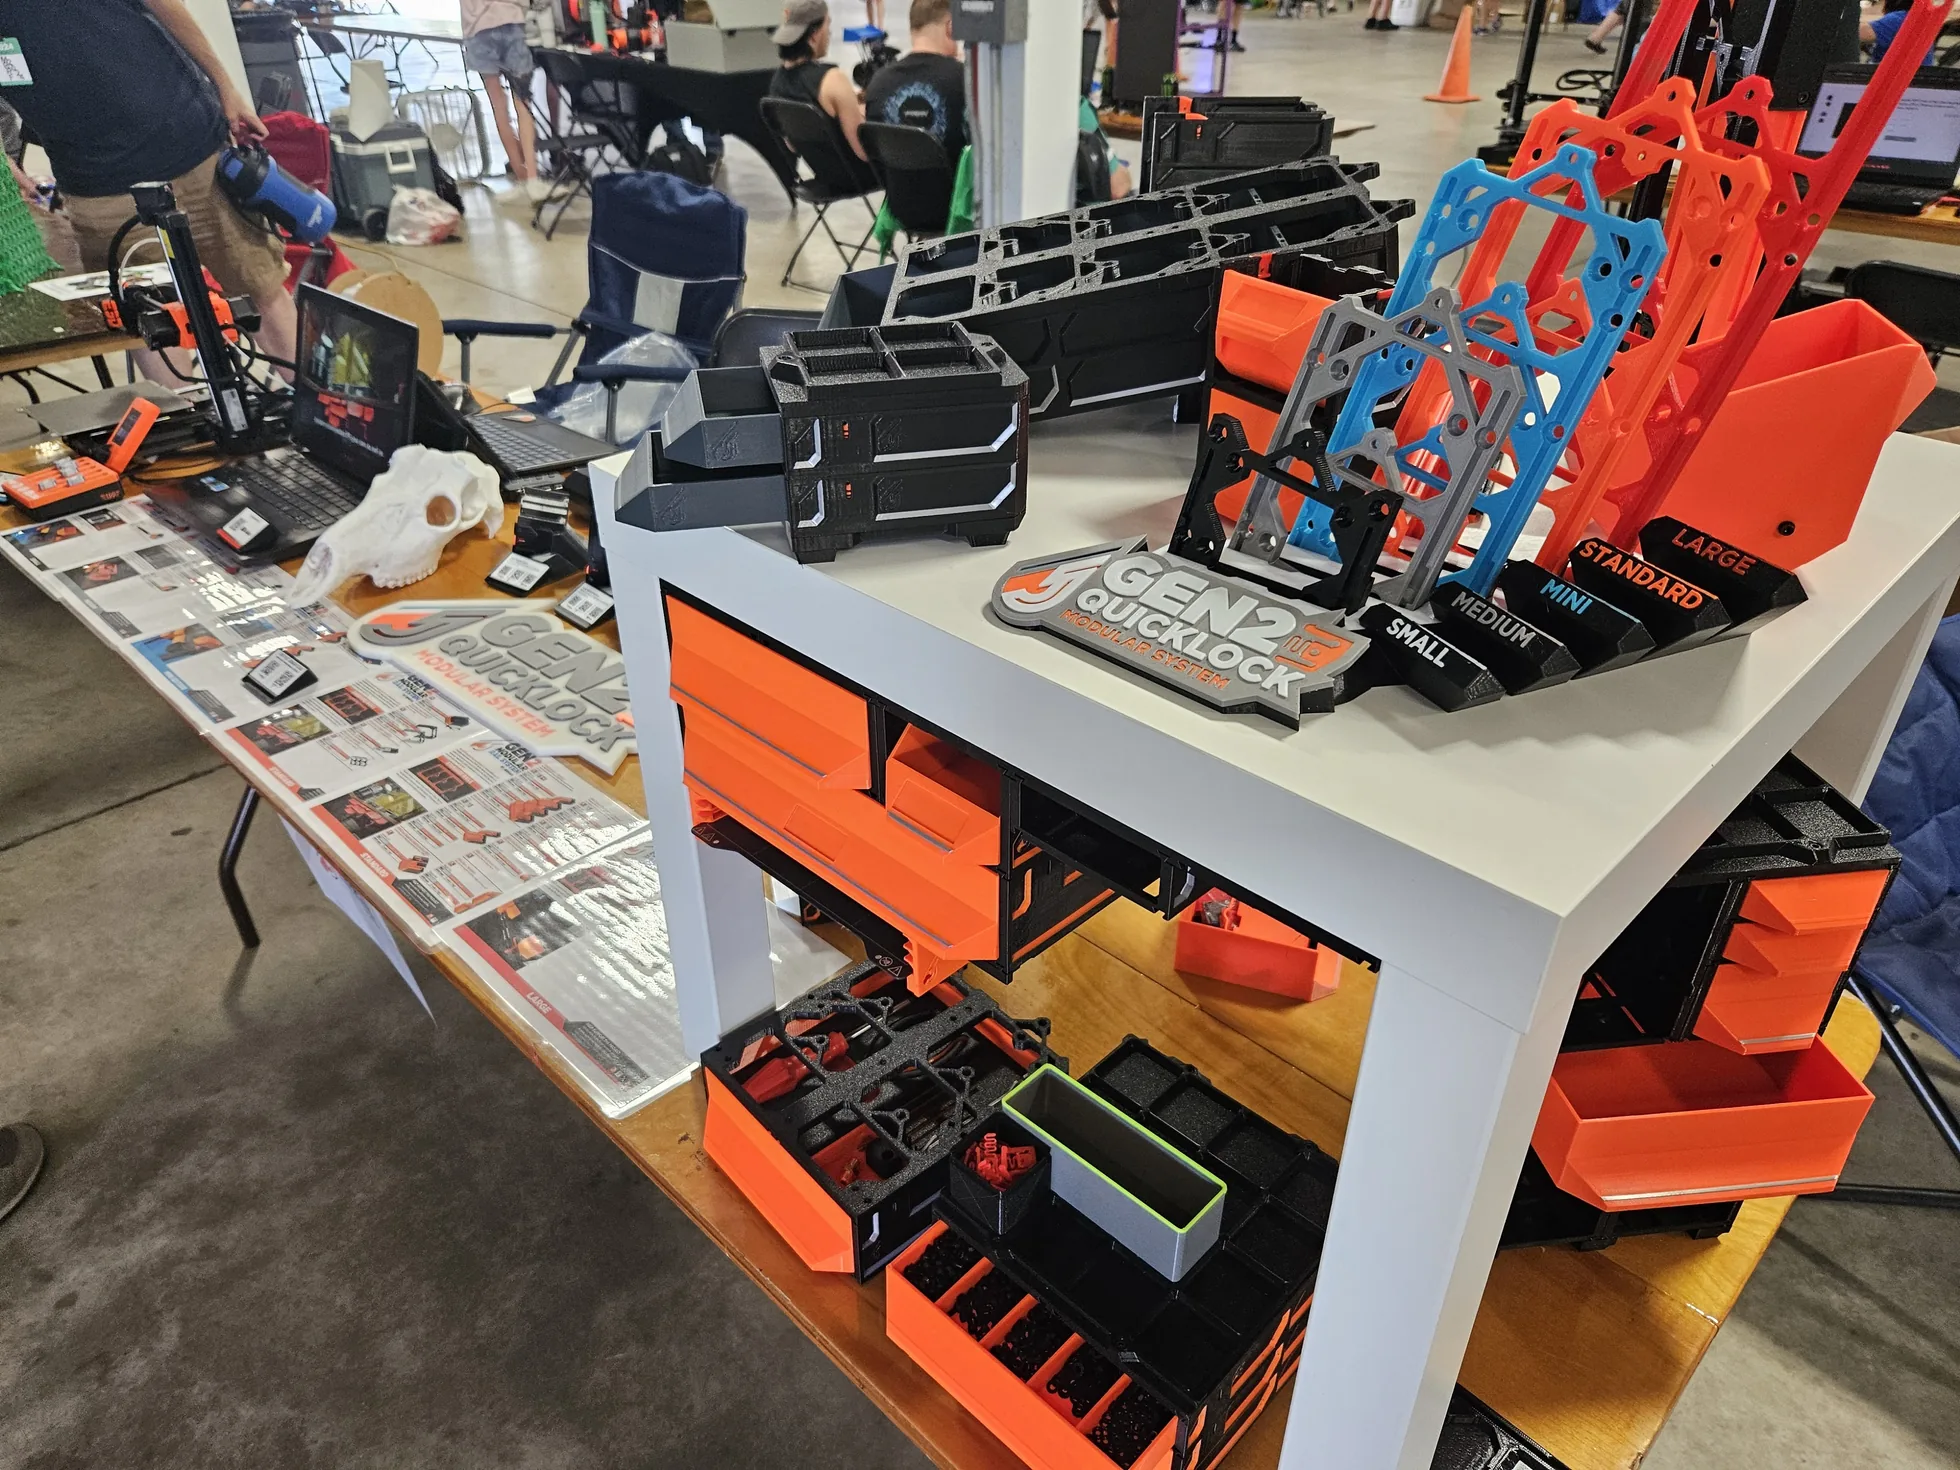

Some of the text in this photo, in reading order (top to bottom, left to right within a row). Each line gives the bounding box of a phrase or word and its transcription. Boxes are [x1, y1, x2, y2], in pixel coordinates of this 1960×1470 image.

[1579, 541, 1703, 610] STANDARD
[1672, 529, 1757, 576] LARGE
[1103, 556, 1297, 656] GEN2
[1451, 592, 1535, 650] MEDIUM
[1539, 579, 1593, 616] MINI
[1060, 609, 1231, 690] MODULAR SYSTEM
[1077, 588, 1306, 698] QUICKLOCK
[1386, 618, 1449, 669] SMALL
[415, 648, 492, 698] MODULAR
[486, 694, 557, 738] SYSTEM
[439, 634, 636, 752] QUICKLOCK
[526, 991, 552, 1014] LARGE
